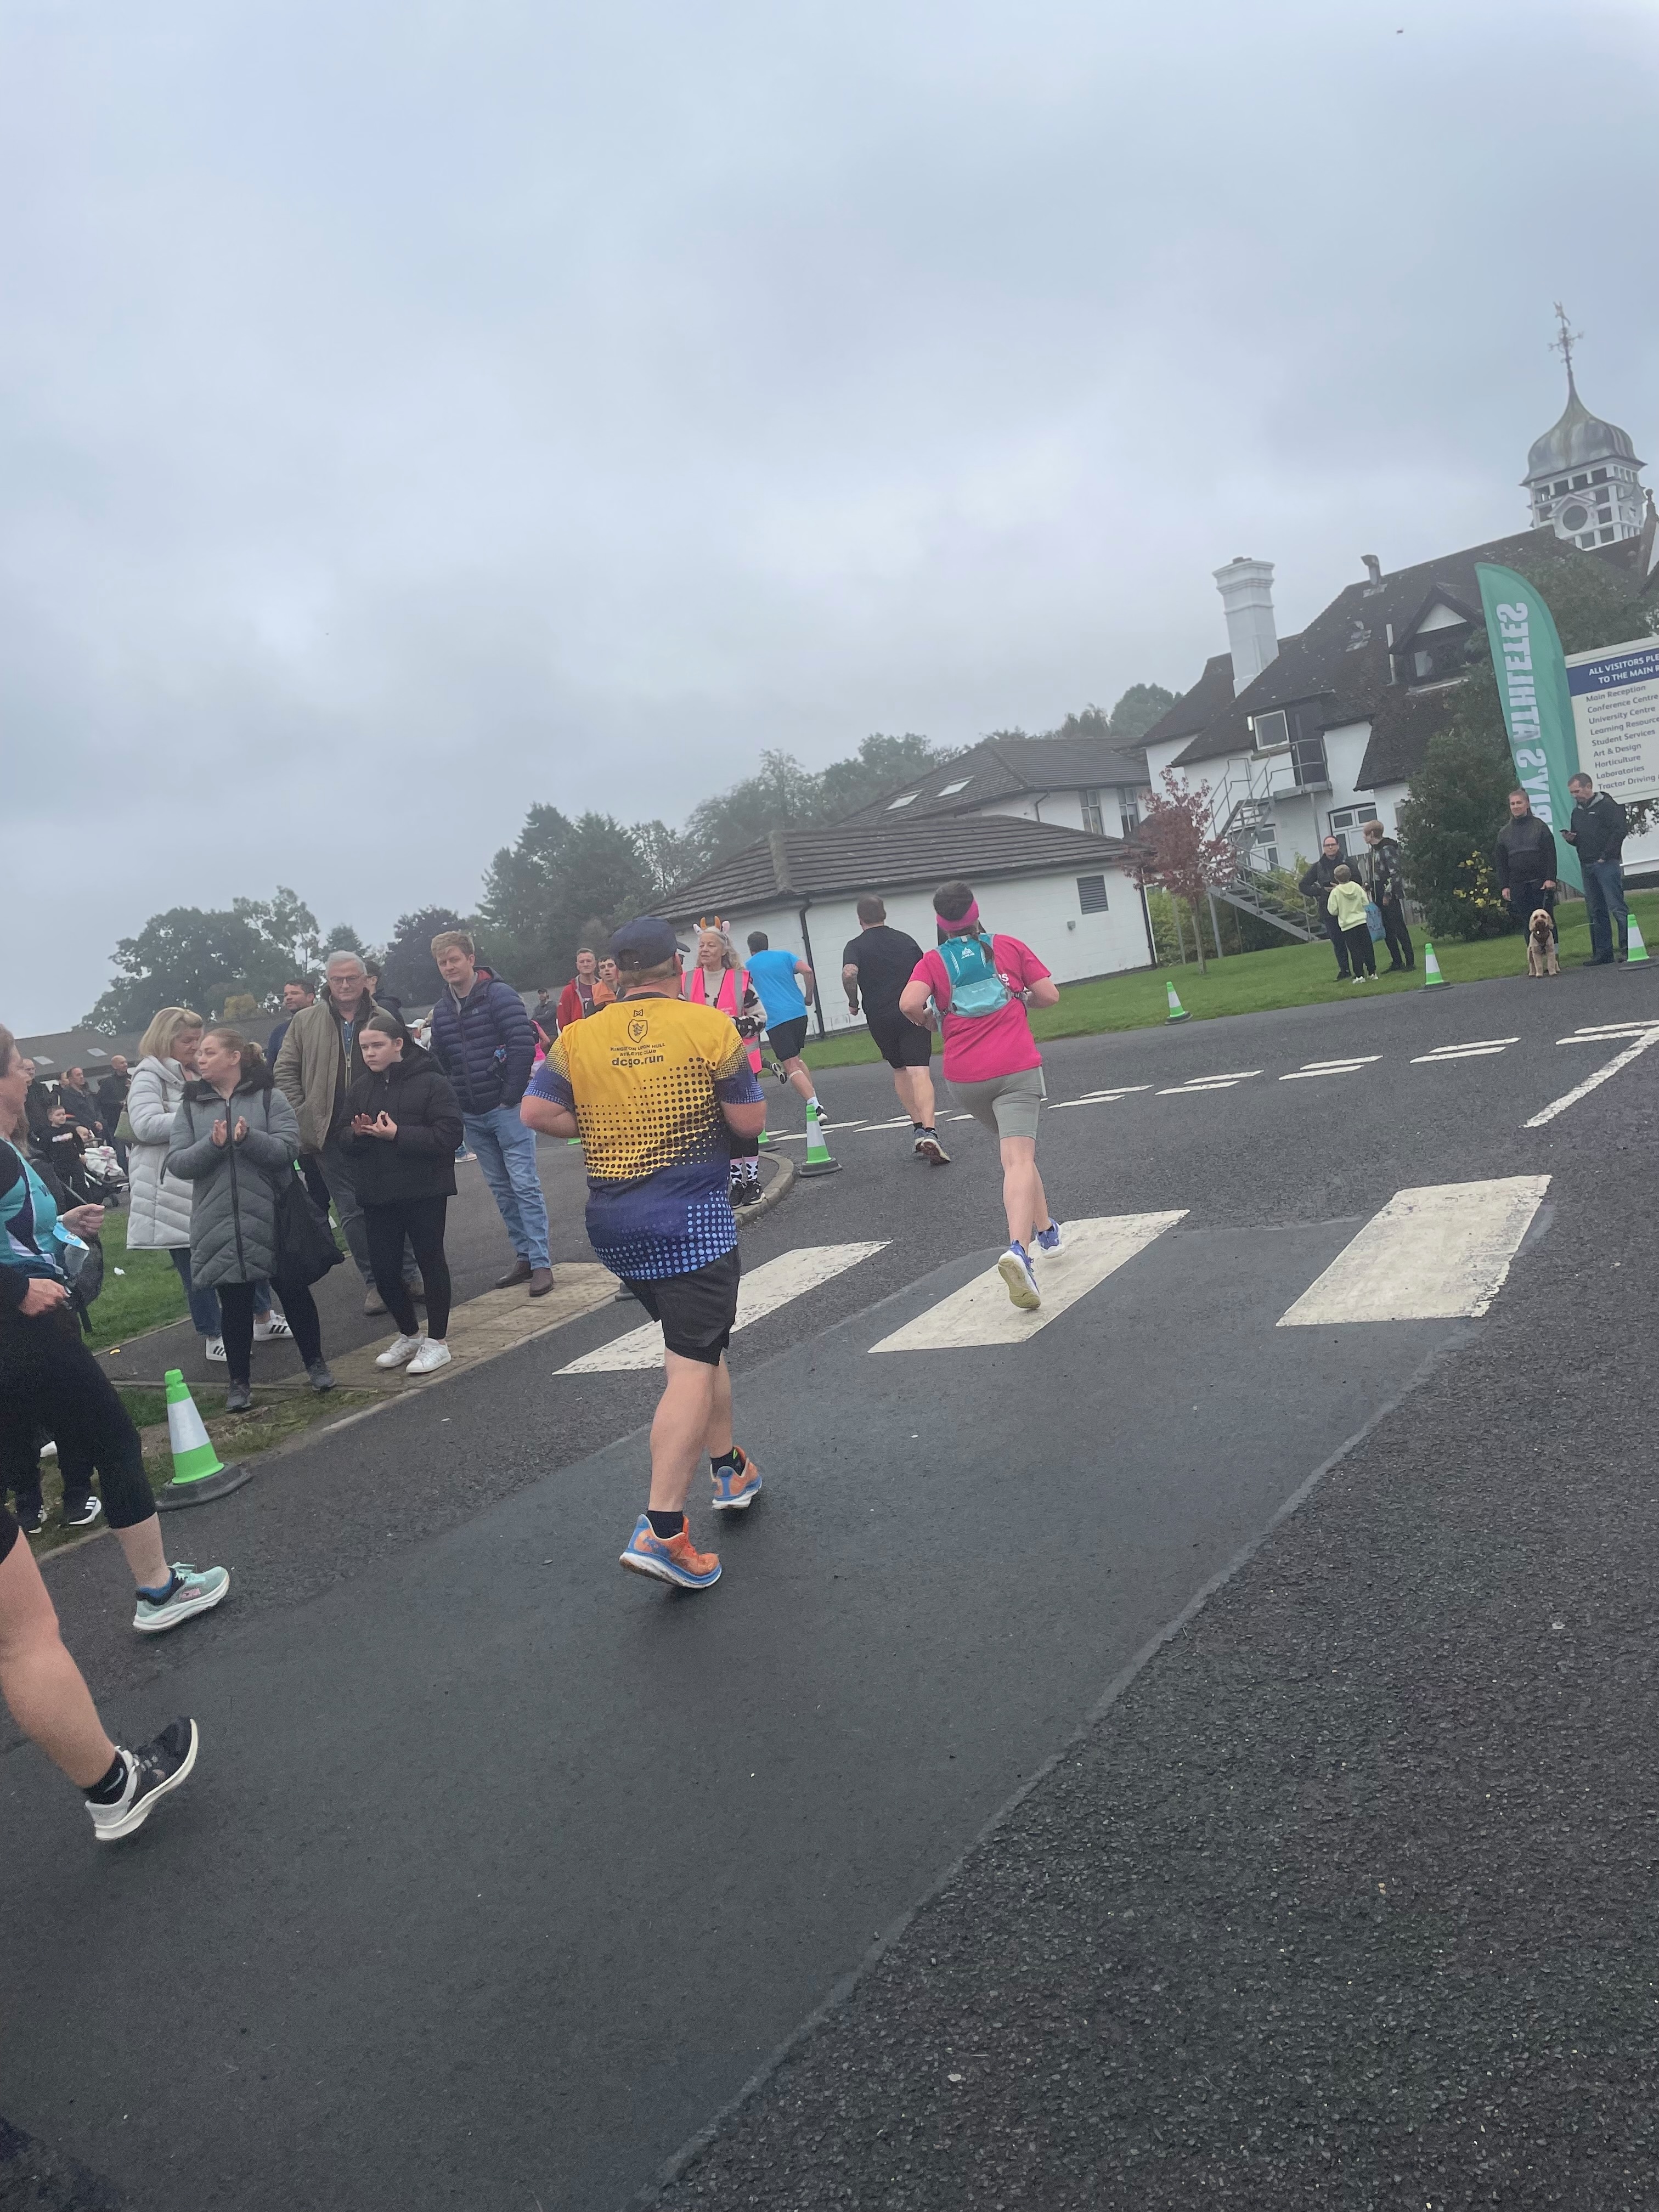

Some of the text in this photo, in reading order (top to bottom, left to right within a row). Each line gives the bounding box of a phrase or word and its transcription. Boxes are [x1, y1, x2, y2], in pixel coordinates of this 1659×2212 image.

[1588, 667, 1604, 676] ALL
[1605, 657, 1644, 672] VISITORS
[1598, 675, 1611, 684] TO
[1611, 672, 1629, 681] THE
[1629, 666, 1654, 678] MAIN
[1586, 685, 1646, 703] Main Reception
[1587, 694, 1659, 714] Conference Centre
[1588, 706, 1656, 725] University Centre
[1590, 724, 1624, 736] Learning
[1592, 729, 1656, 747] Student Services
[1593, 749, 1606, 758] Art
[1615, 743, 1642, 753] Design
[1595, 755, 1641, 769] Horticulture
[1596, 765, 1645, 780] Laboratories
[1598, 780, 1626, 791] Tractor
[1627, 775, 1656, 785] Driving
[612, 1055, 664, 1068] dcgo.run
